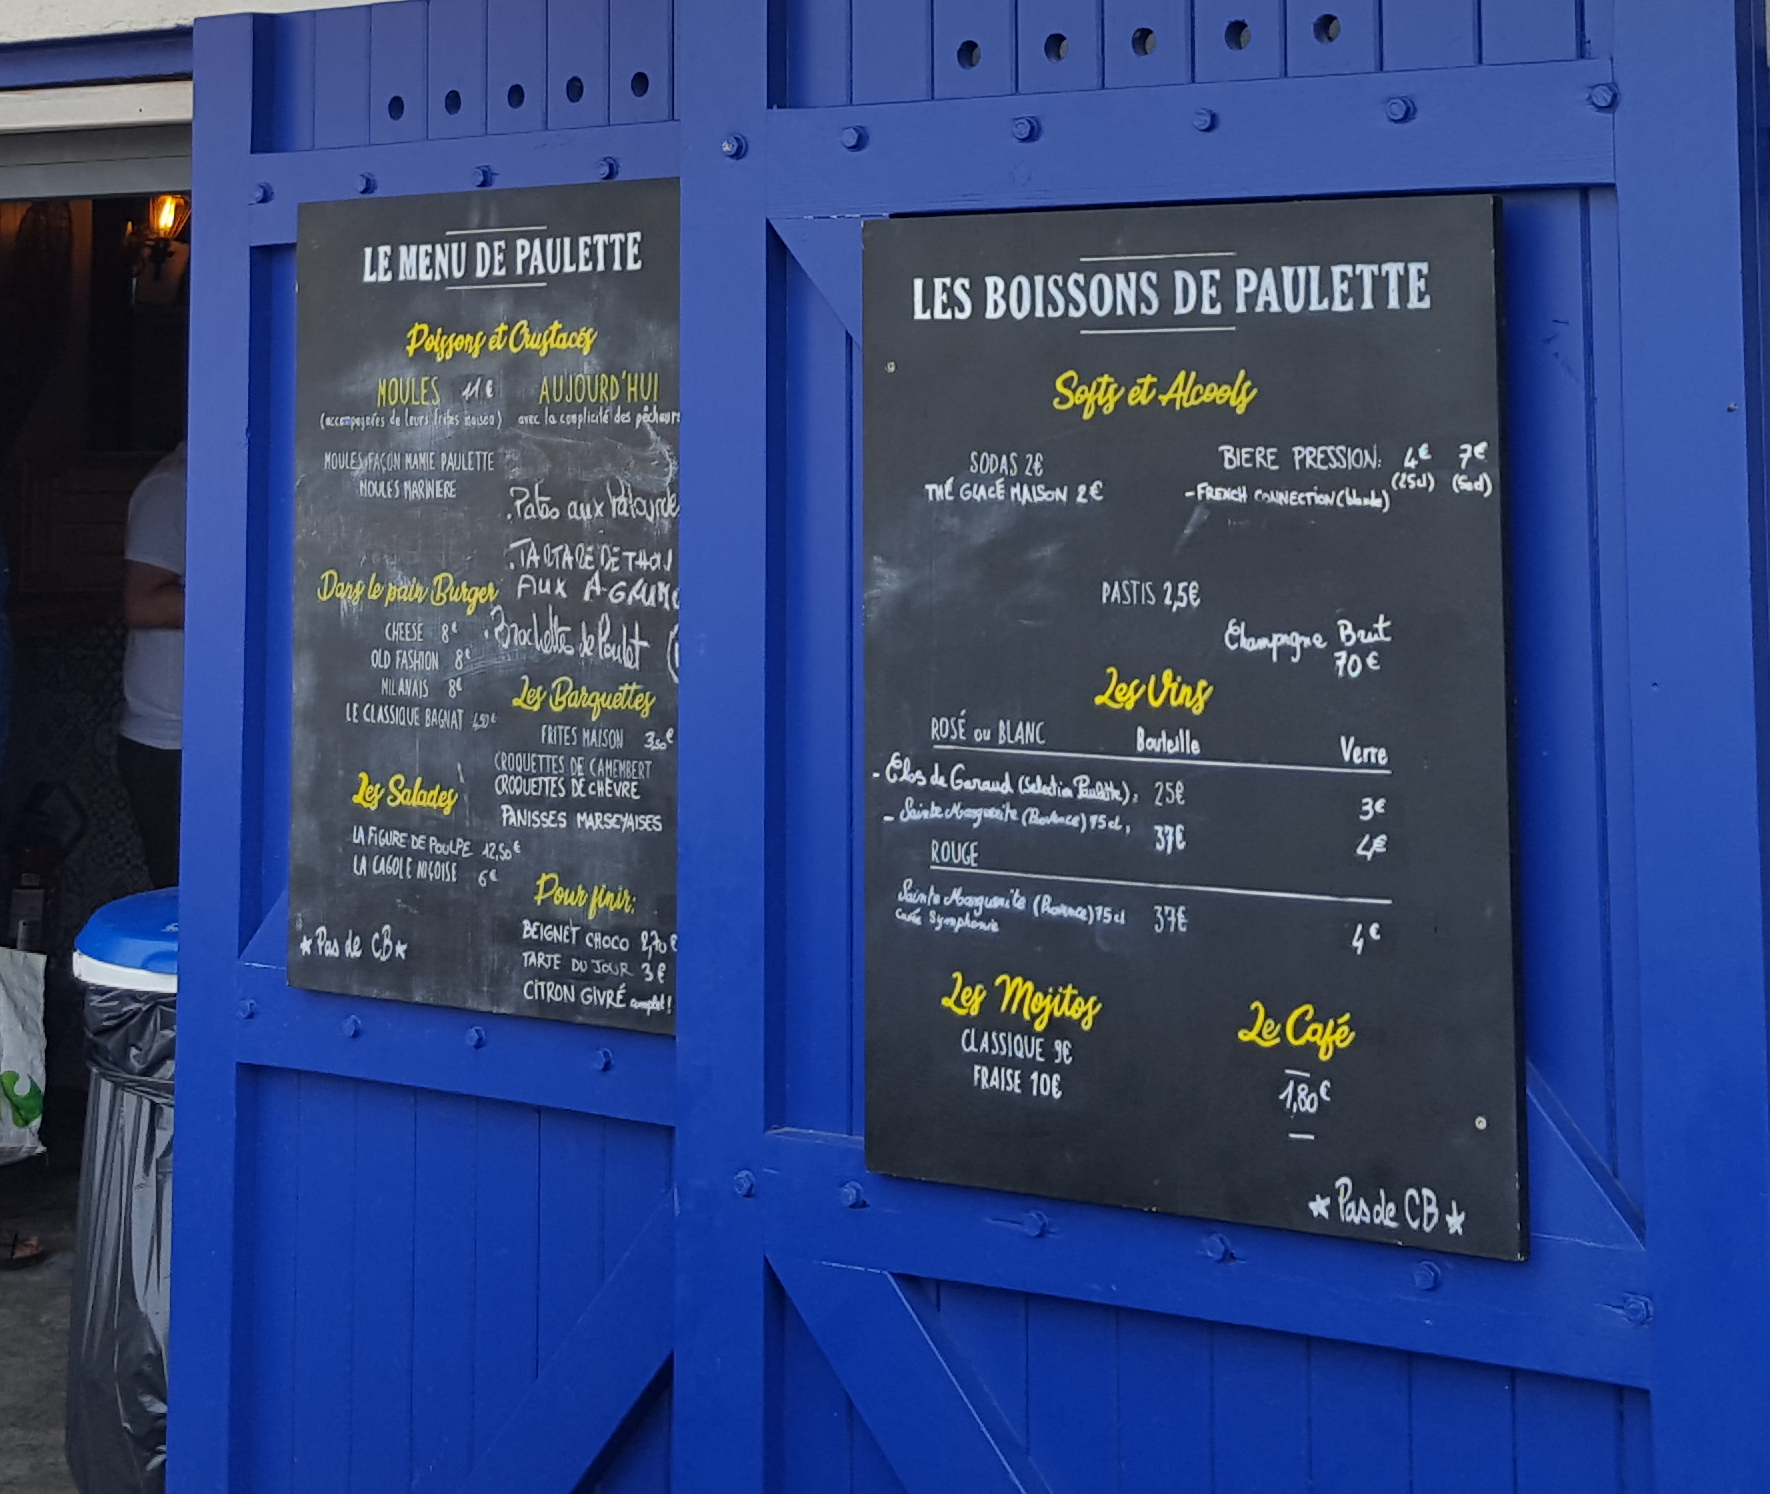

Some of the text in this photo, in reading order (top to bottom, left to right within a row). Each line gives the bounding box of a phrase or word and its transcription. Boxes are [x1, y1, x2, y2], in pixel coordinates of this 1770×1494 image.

[363, 232, 642, 282] LE MENU DE PAULETTE
[913, 261, 1431, 320] LES BOISSONS DE PAULETTE
[406, 319, 598, 363] Poissons et Crustacés
[377, 376, 440, 407] MOULES
[538, 370, 659, 404] AUJOURD'HUI
[1053, 369, 1258, 420] Softs et Alcools
[518, 413, 540, 425] avec
[545, 410, 557, 425] la
[614, 406, 631, 423] des
[441, 452, 494, 471] PAULETTE
[970, 451, 1043, 477] SODAS 2€
[1219, 445, 1279, 470] BIERE
[1404, 443, 1431, 469] 4€
[1459, 442, 1488, 469] 7€
[359, 479, 399, 498] MOULES
[925, 476, 954, 501] THÉ
[1011, 484, 1067, 505] MAISON
[568, 501, 604, 520] aux
[317, 569, 499, 616] Dans le pain Burger
[517, 575, 567, 599] AUX
[1101, 581, 1200, 612] PASTIS 2,5€
[385, 622, 424, 642] CHEESE
[1224, 614, 1391, 662] Champagne Brut
[371, 648, 391, 669] OLD
[396, 650, 439, 671] FASHION
[381, 678, 428, 698] MILANAIS
[512, 675, 656, 721] Les Barquettes
[1094, 667, 1213, 714] Les Vins
[346, 703, 464, 730] LE CLASSIQUE BAGNAT
[541, 724, 624, 749] FRITES MAISON
[931, 709, 1388, 765] ROSÉ ou BLANC Bouteille Verre
[494, 751, 652, 779] CROQUETTES DE CAMEMBERT
[886, 752, 926, 786] Clos
[931, 763, 948, 788] de
[1155, 781, 1184, 806] 25€
[352, 772, 458, 815] Les Salades
[495, 774, 586, 797] CROQUETTES DE
[501, 804, 662, 833] PANISSES MARSEYAISES
[353, 825, 364, 845] LA
[411, 834, 426, 850] DE
[931, 838, 978, 866] ROUGE
[1154, 824, 1186, 854] 37€
[353, 855, 367, 876] LA
[373, 855, 412, 879] CAGOLE
[534, 872, 588, 906] Pour
[1154, 906, 1187, 932] 37€
[315, 924, 392, 961] Pas de CB
[522, 919, 629, 951] BEIGNET CHOCO
[522, 951, 633, 977] TARTE DU JOUR
[941, 971, 1102, 1031] Les Mojitos
[1238, 1000, 1356, 1061] Le Café
[961, 1028, 1072, 1064] CLASSIQUE 9€
[974, 1064, 1062, 1099] FRAISE 10€
[1335, 1176, 1439, 1233] Pas de CB
